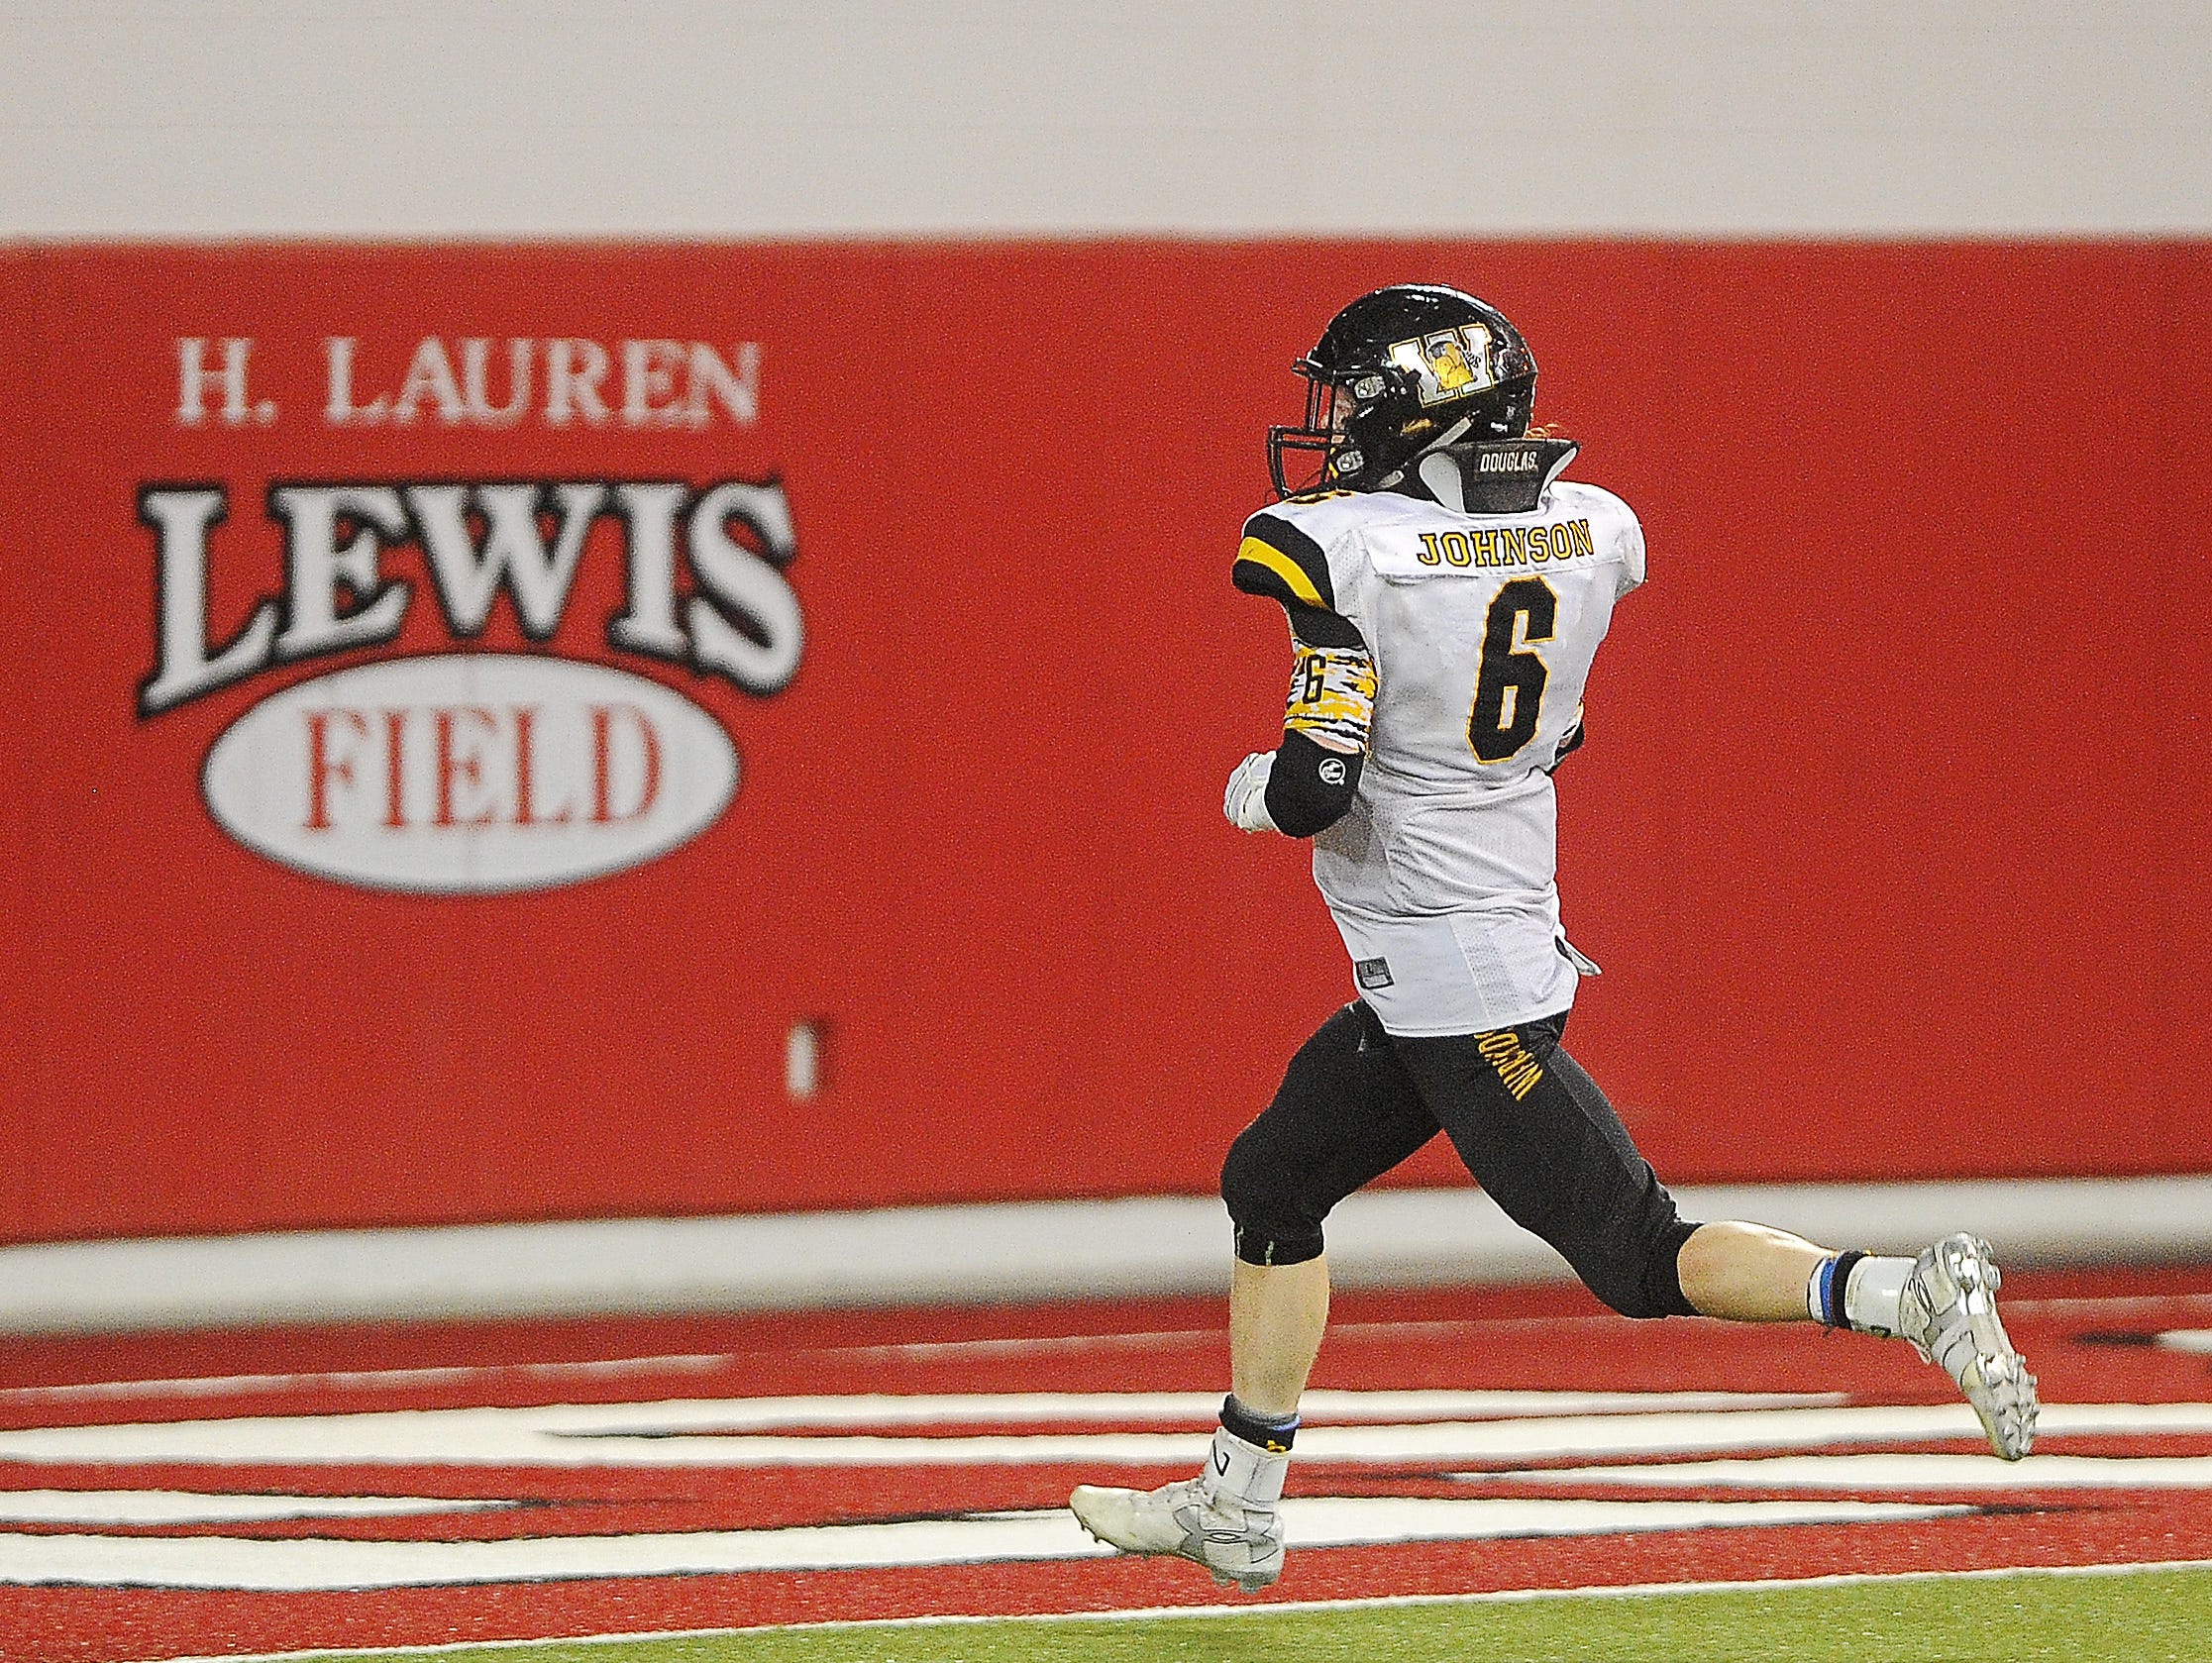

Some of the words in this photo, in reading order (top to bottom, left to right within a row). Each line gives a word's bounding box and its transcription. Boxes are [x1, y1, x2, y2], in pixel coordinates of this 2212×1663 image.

[178, 337, 277, 425] H.
[326, 337, 763, 428] LAUREN
[138, 474, 803, 717] LEWIS
[1417, 519, 1594, 568] JOHNSON
[1302, 655, 1326, 704] 6
[1466, 574, 1559, 764] 6
[302, 703, 664, 831] FIELD
